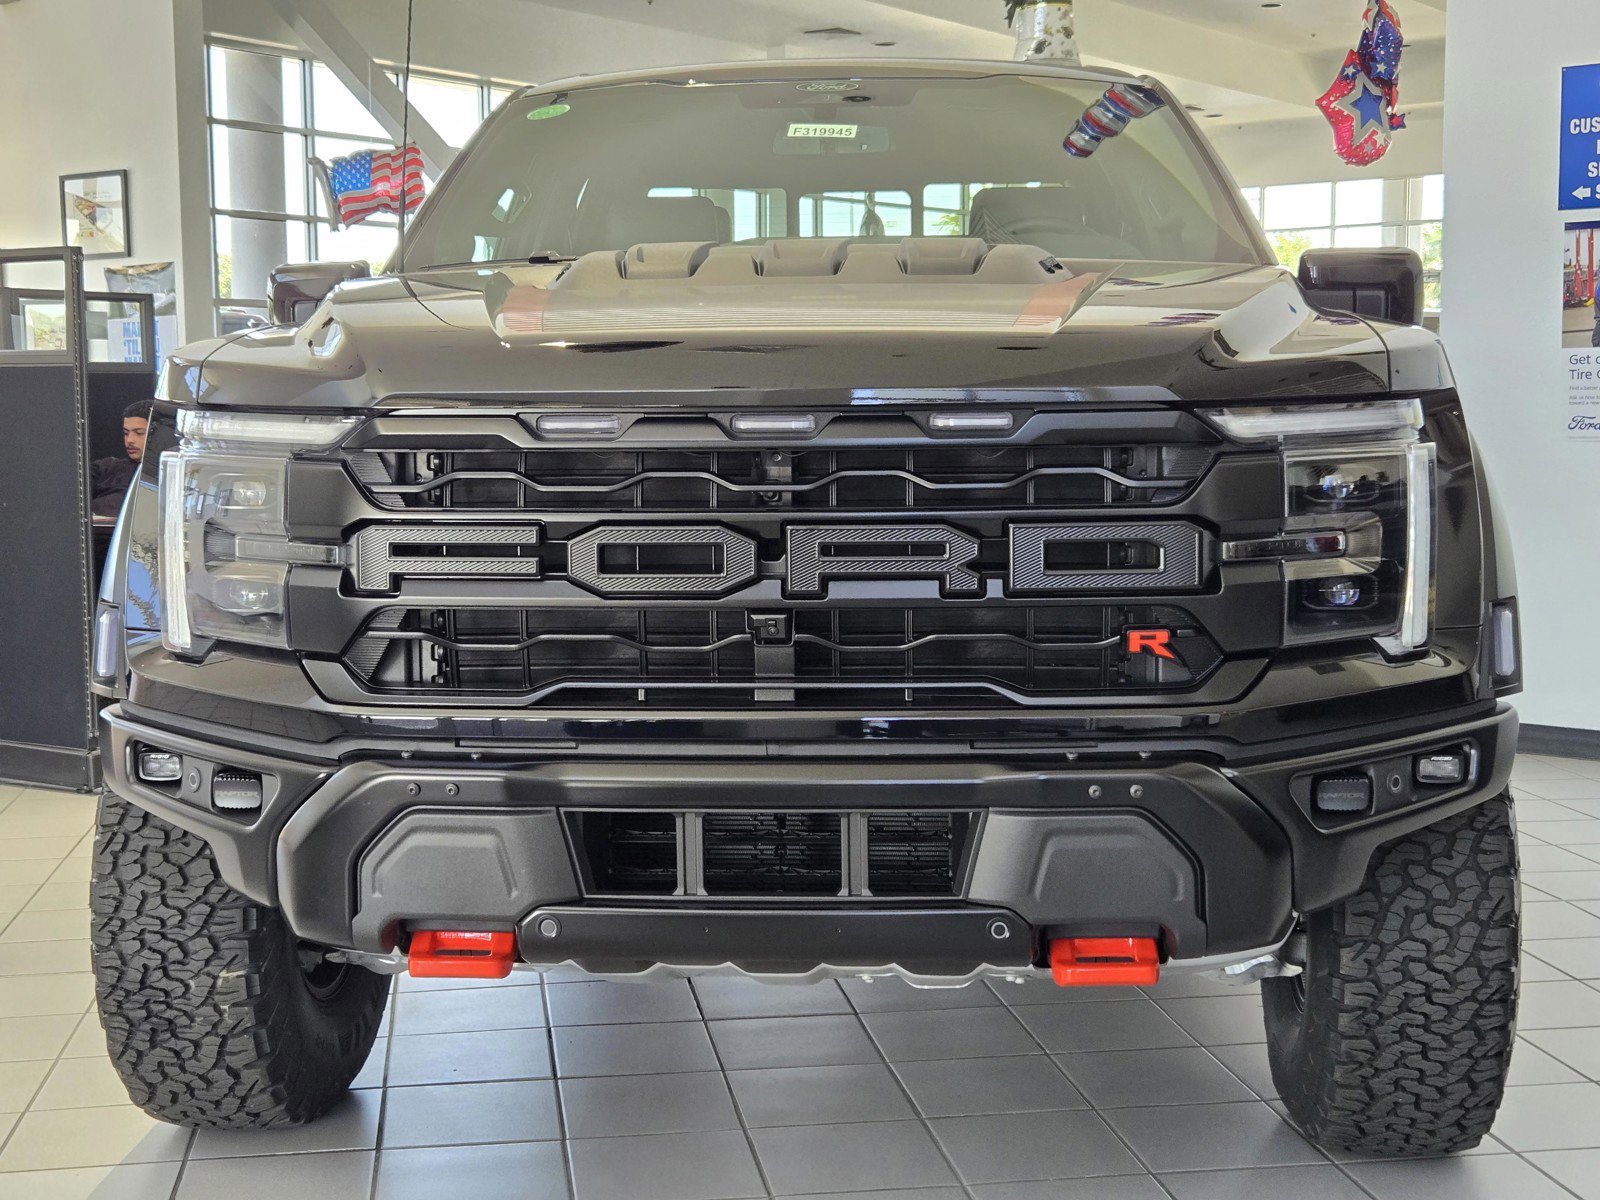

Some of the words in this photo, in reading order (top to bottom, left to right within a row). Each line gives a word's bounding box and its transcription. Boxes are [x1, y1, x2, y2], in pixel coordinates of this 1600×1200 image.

[793, 127, 852, 136] F319945
[1569, 354, 1591, 365] Get
[1569, 368, 1593, 380] Tire
[355, 521, 1203, 594] FORD
[1126, 629, 1176, 659] R
